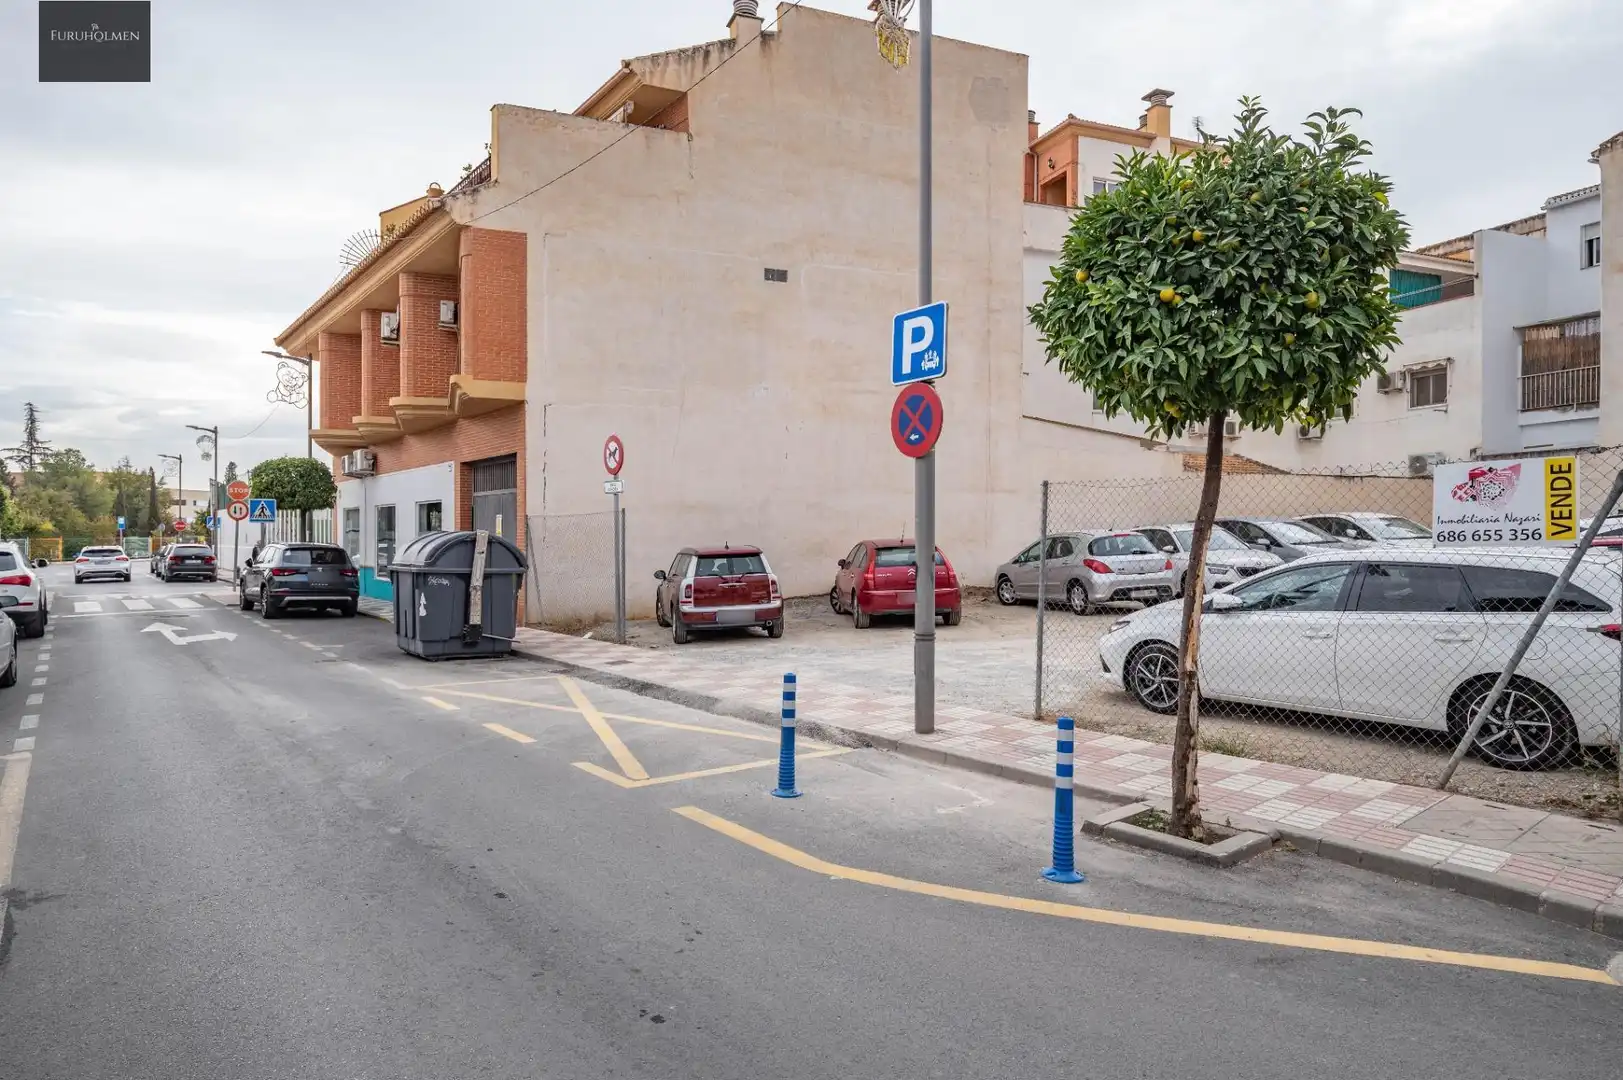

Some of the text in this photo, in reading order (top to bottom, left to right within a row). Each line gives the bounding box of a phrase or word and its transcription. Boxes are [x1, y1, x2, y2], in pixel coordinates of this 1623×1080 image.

[902, 315, 934, 374] P
[1550, 462, 1573, 537] VENDE
[1436, 528, 1542, 542] 686 655 356
[1437, 513, 1500, 525] Inmobiliaria
